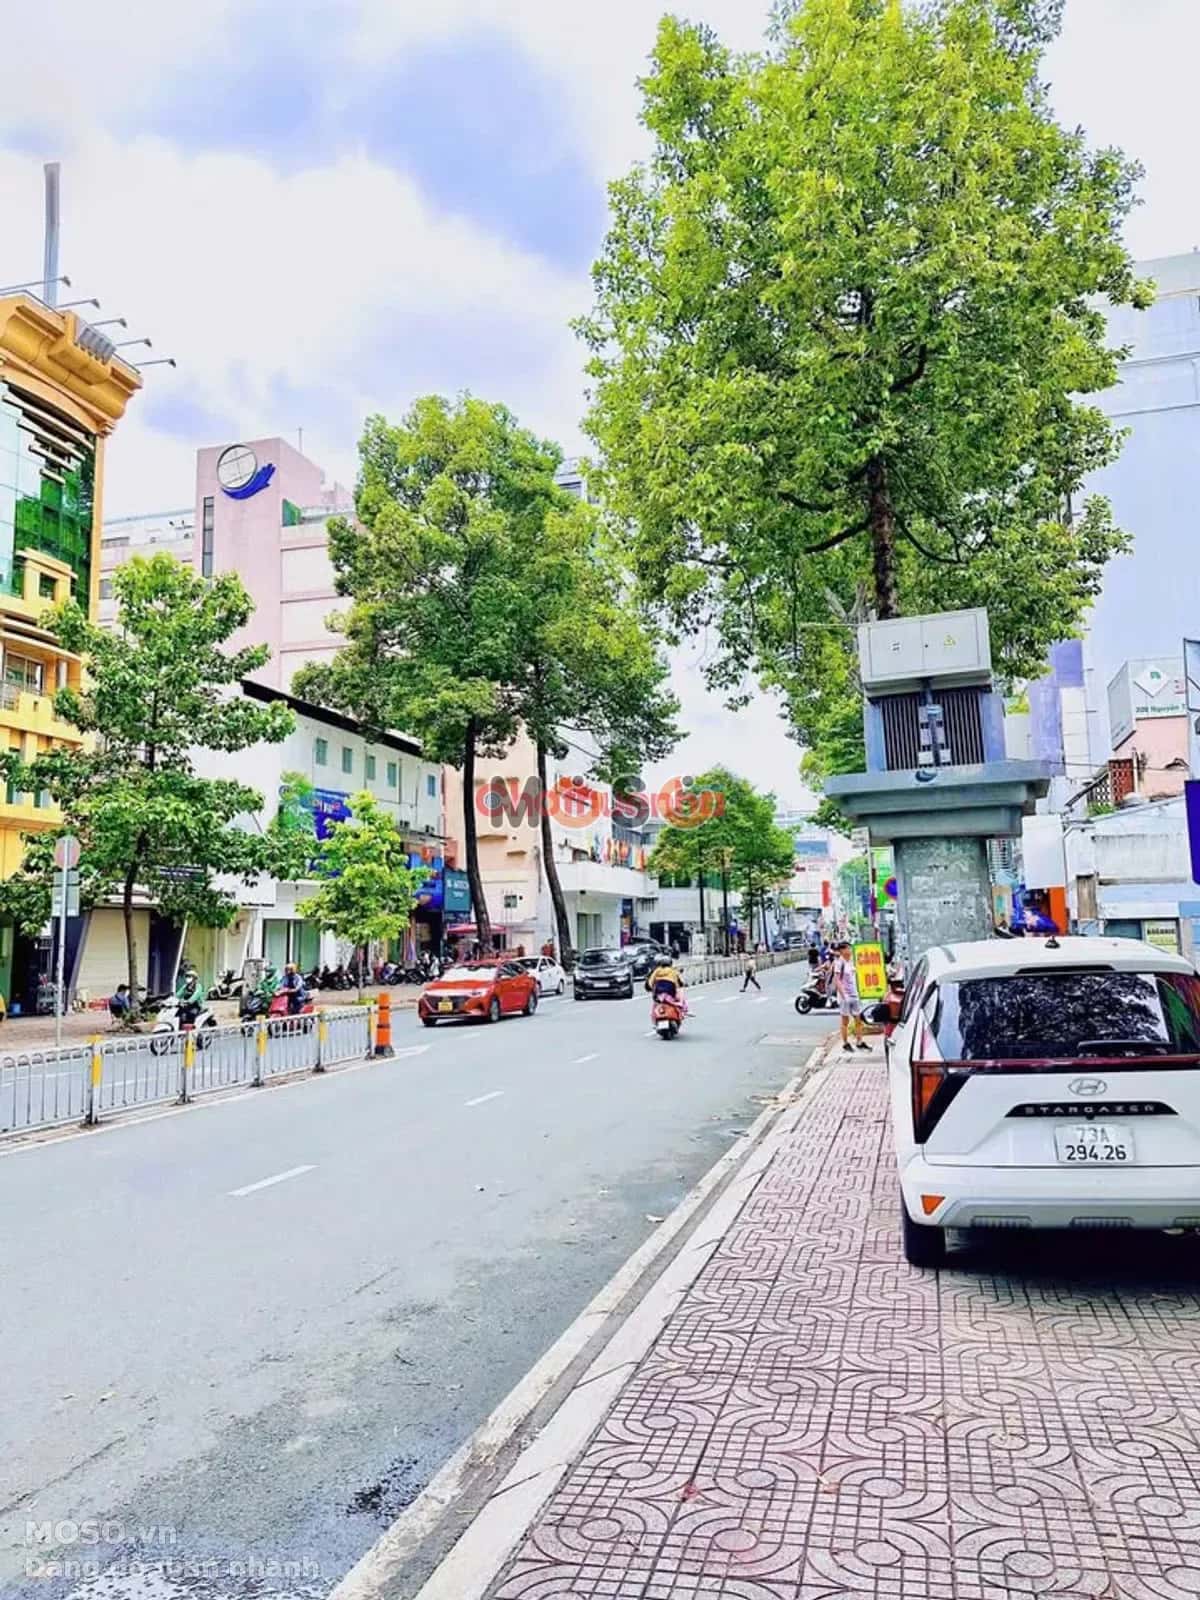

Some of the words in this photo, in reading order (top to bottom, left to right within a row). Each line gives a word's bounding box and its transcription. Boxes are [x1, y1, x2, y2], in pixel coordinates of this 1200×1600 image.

[1024, 1104, 1156, 1115] STARGAZER
[1076, 1127, 1110, 1143] 73A
[1065, 1144, 1127, 1161] 294.26
